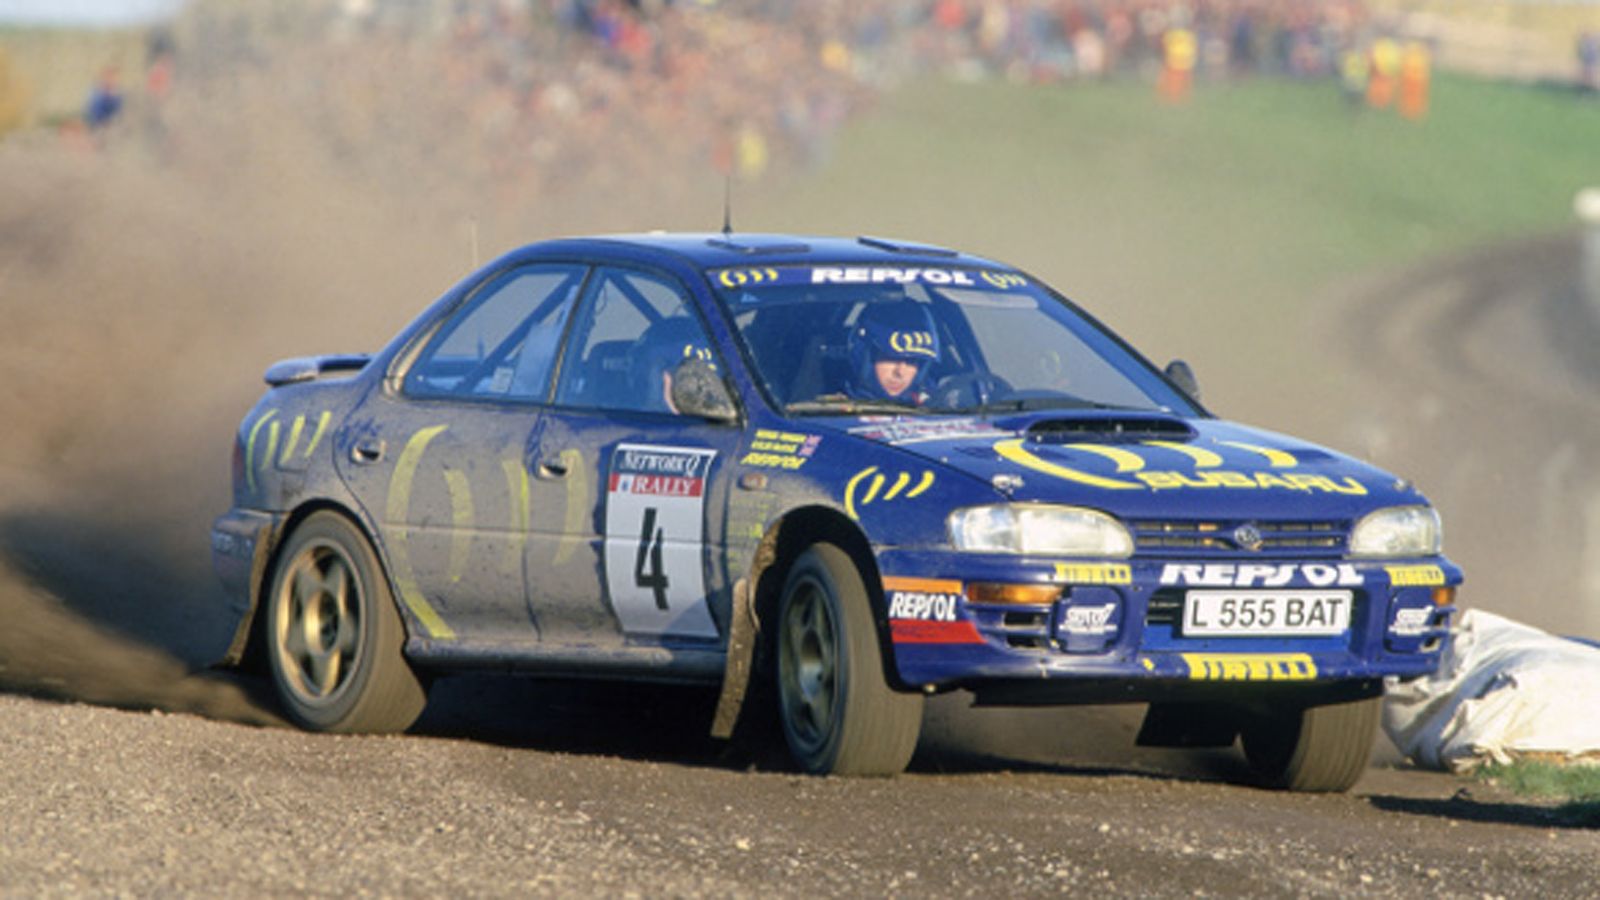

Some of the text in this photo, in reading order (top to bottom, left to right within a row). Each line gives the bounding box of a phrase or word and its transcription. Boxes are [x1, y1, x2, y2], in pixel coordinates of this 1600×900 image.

[811, 267, 974, 284] REPSOL
[685, 453, 701, 478] Q
[635, 475, 695, 496] RALLY
[1136, 471, 1368, 495] SUBARU
[635, 507, 670, 611] 4
[1159, 563, 1365, 586] REPSOL
[889, 592, 957, 621] REPSOL
[1191, 599, 1345, 628] L 555 BAT
[1181, 652, 1318, 681] PIRELLI
